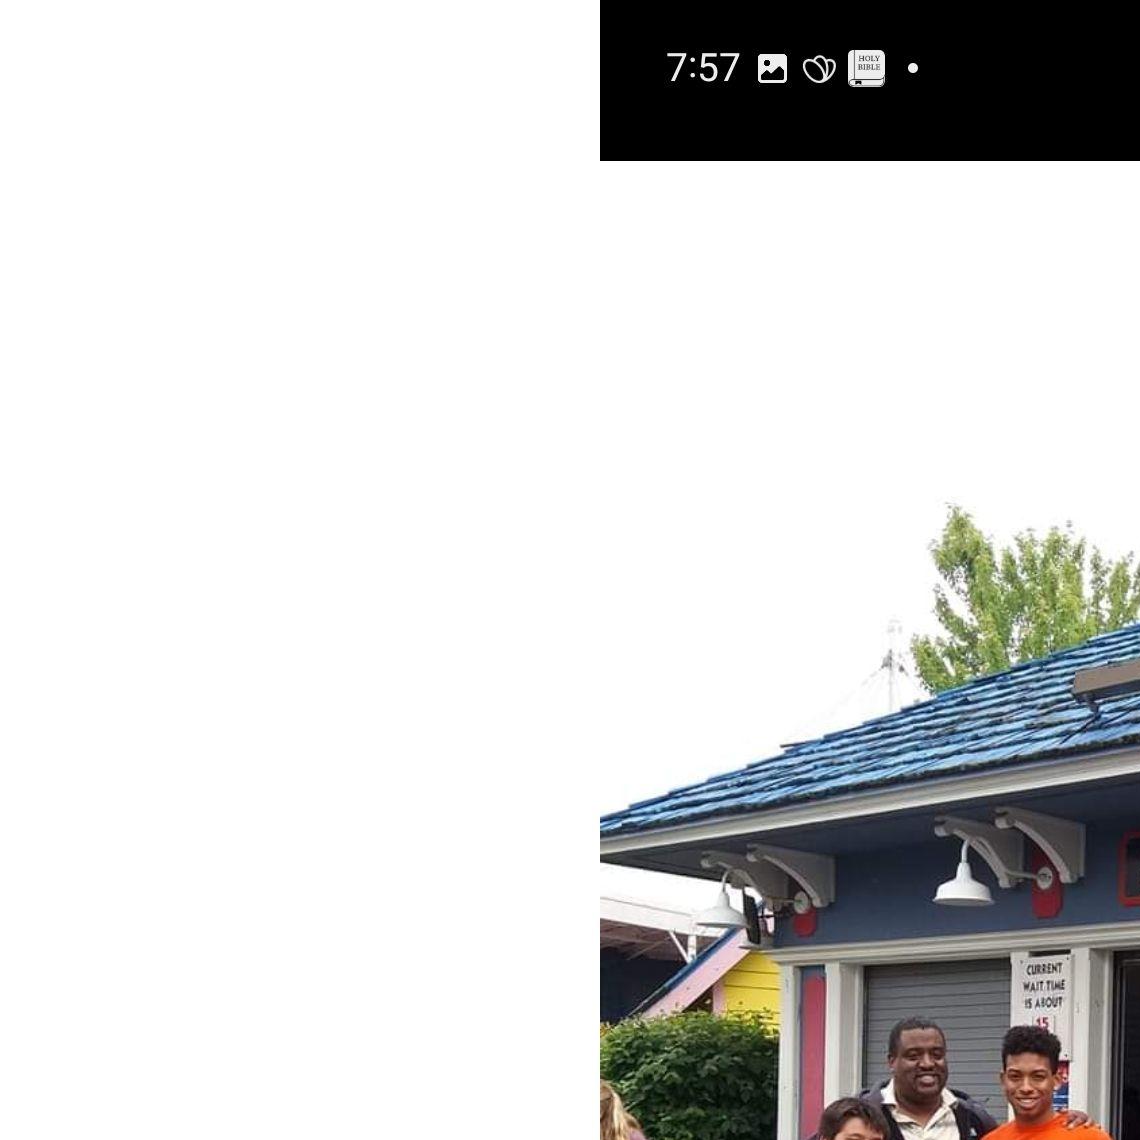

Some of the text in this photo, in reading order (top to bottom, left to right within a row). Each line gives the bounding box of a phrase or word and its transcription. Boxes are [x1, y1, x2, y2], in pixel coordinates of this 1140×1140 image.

[1026, 962, 1063, 976] CURRENT
[1023, 979, 1065, 993] WAIT TIME
[1024, 996, 1063, 1009] IS ABOUT
